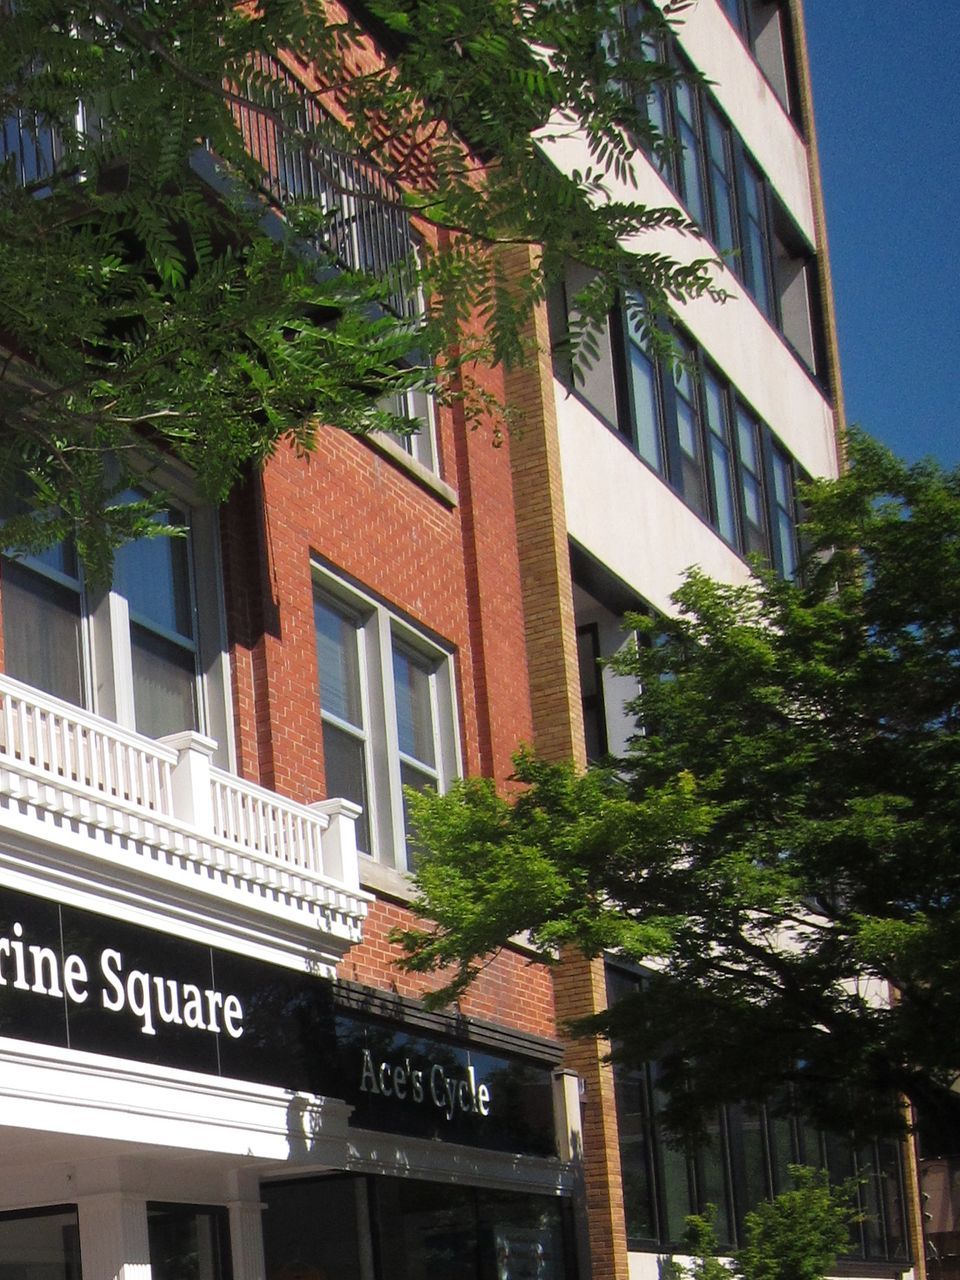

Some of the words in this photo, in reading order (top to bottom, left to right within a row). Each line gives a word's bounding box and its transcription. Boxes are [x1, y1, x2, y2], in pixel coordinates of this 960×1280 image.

[100, 947, 244, 1039] Square
[360, 1049, 423, 1103] Ace's
[430, 1064, 490, 1121] Cycle
